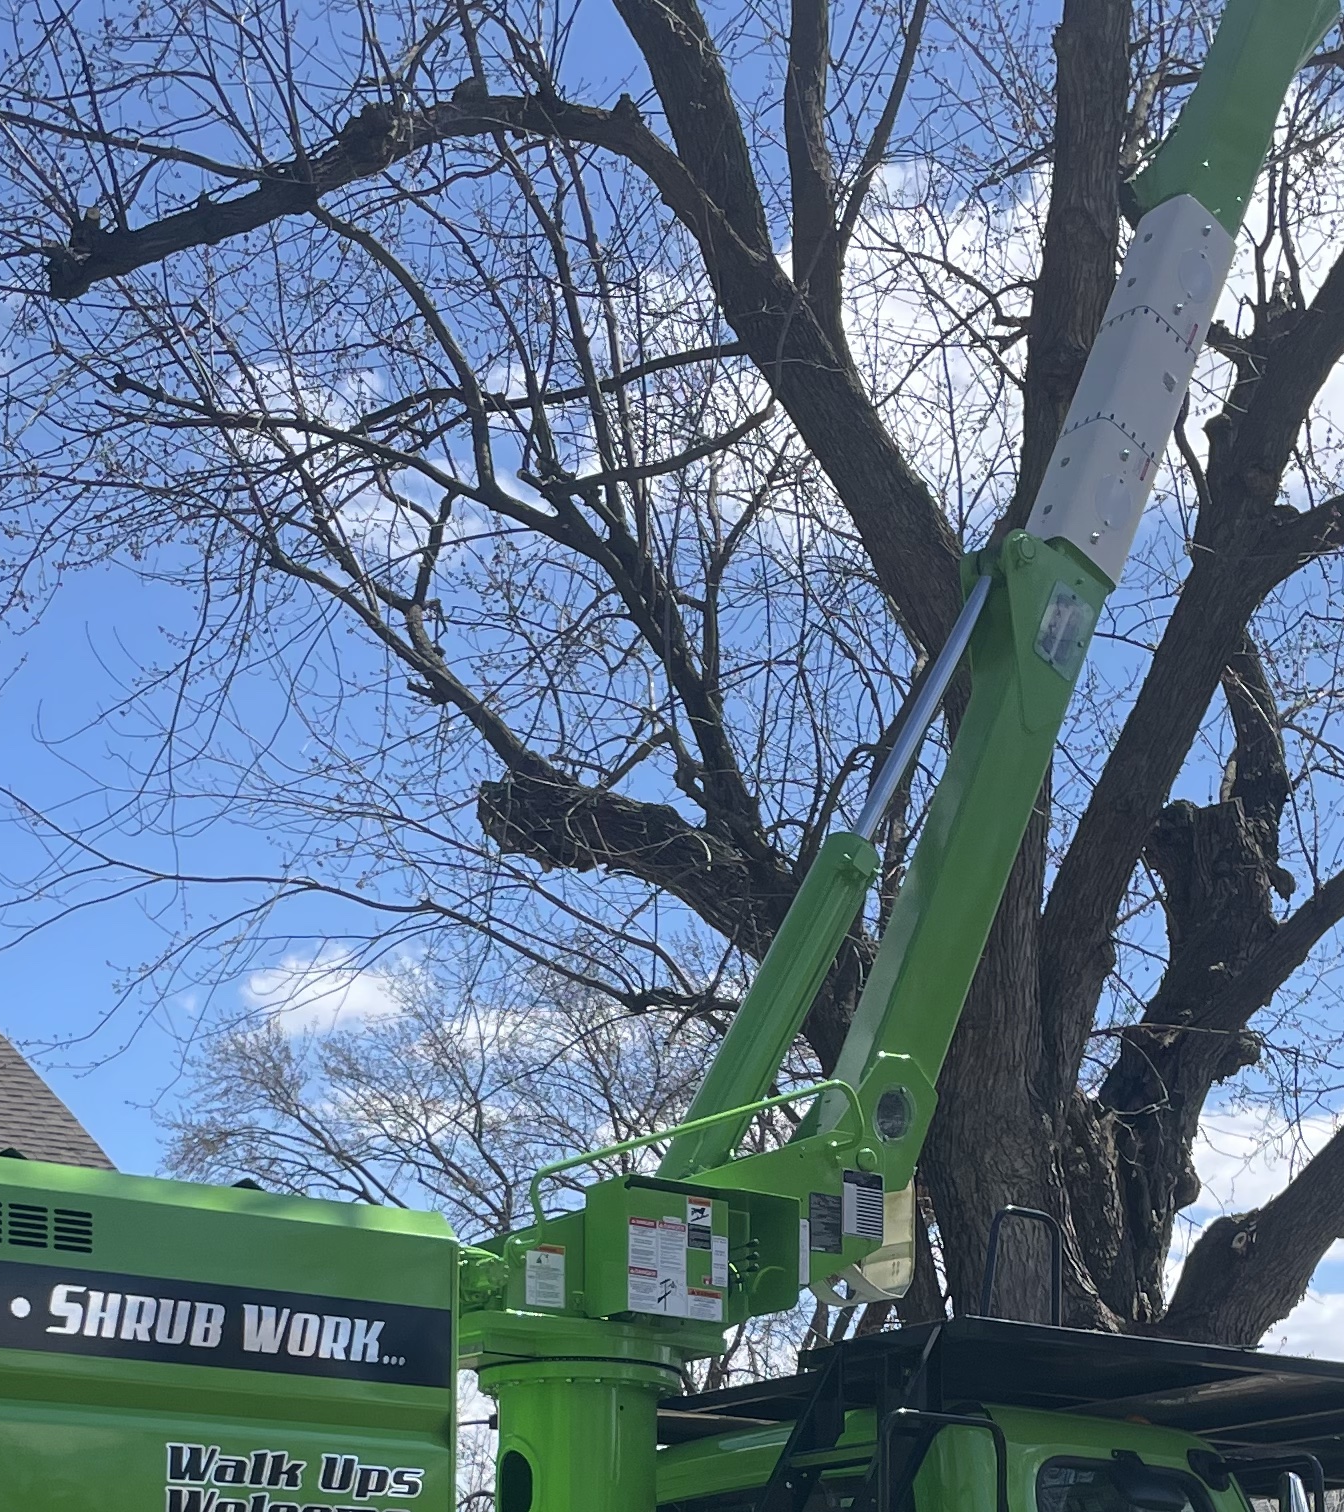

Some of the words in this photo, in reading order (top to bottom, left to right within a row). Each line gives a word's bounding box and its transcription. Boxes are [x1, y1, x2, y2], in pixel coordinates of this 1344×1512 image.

[46, 1285, 226, 1349] SHRUB
[166, 1443, 303, 1493] Walk
[319, 1453, 424, 1500] Ups
